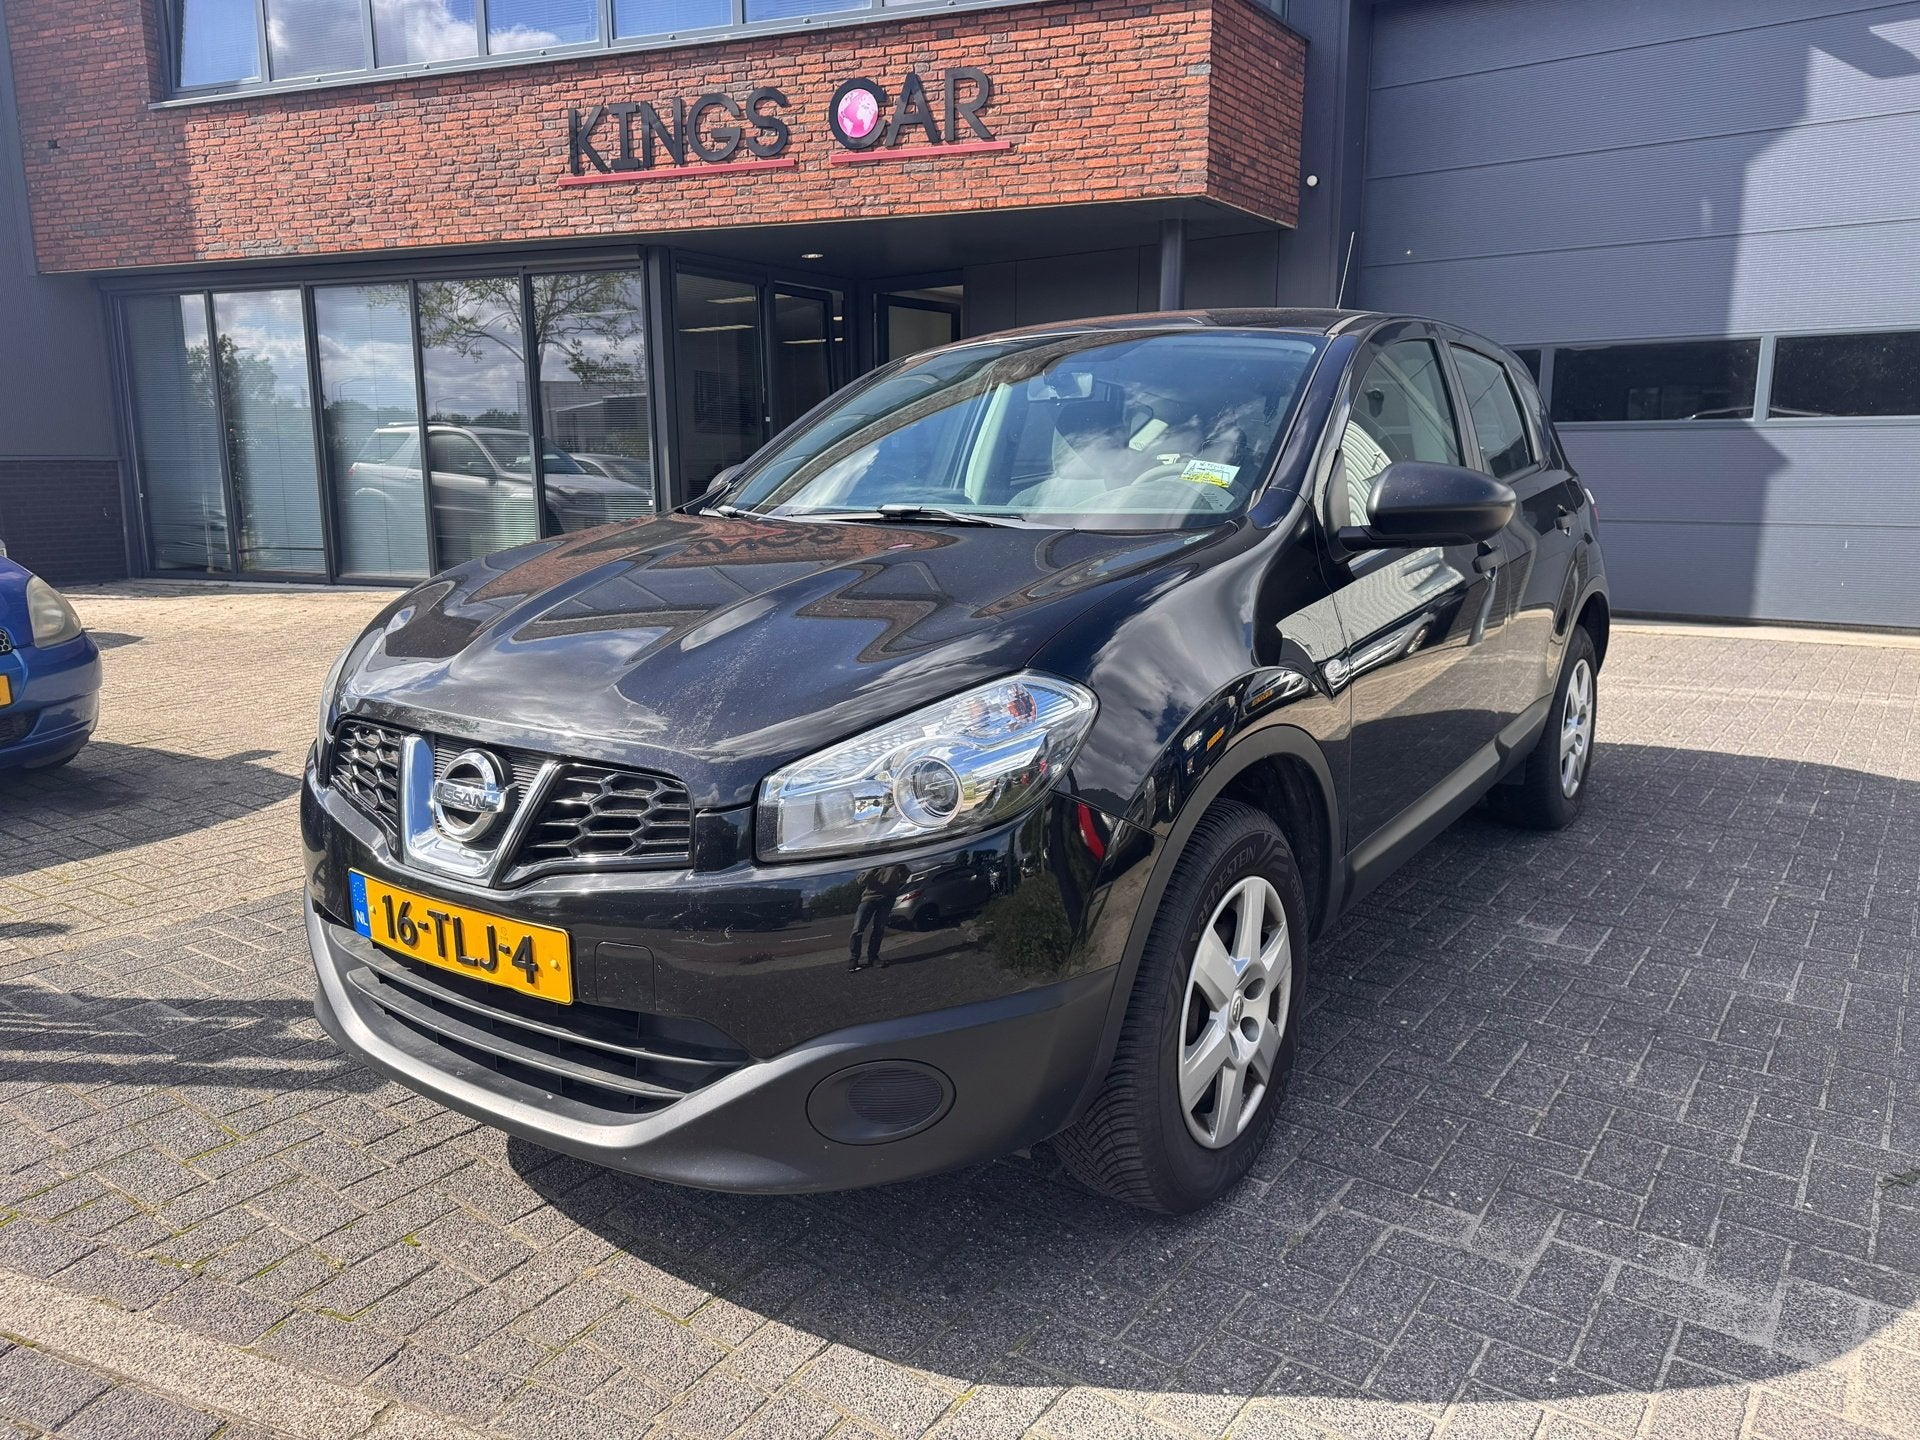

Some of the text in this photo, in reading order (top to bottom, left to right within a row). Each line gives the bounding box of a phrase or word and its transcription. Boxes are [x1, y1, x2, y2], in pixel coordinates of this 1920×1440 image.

[567, 67, 995, 175] KINGS CAR
[355, 910, 369, 927] NL
[381, 894, 539, 984] 16-TLJ-4
